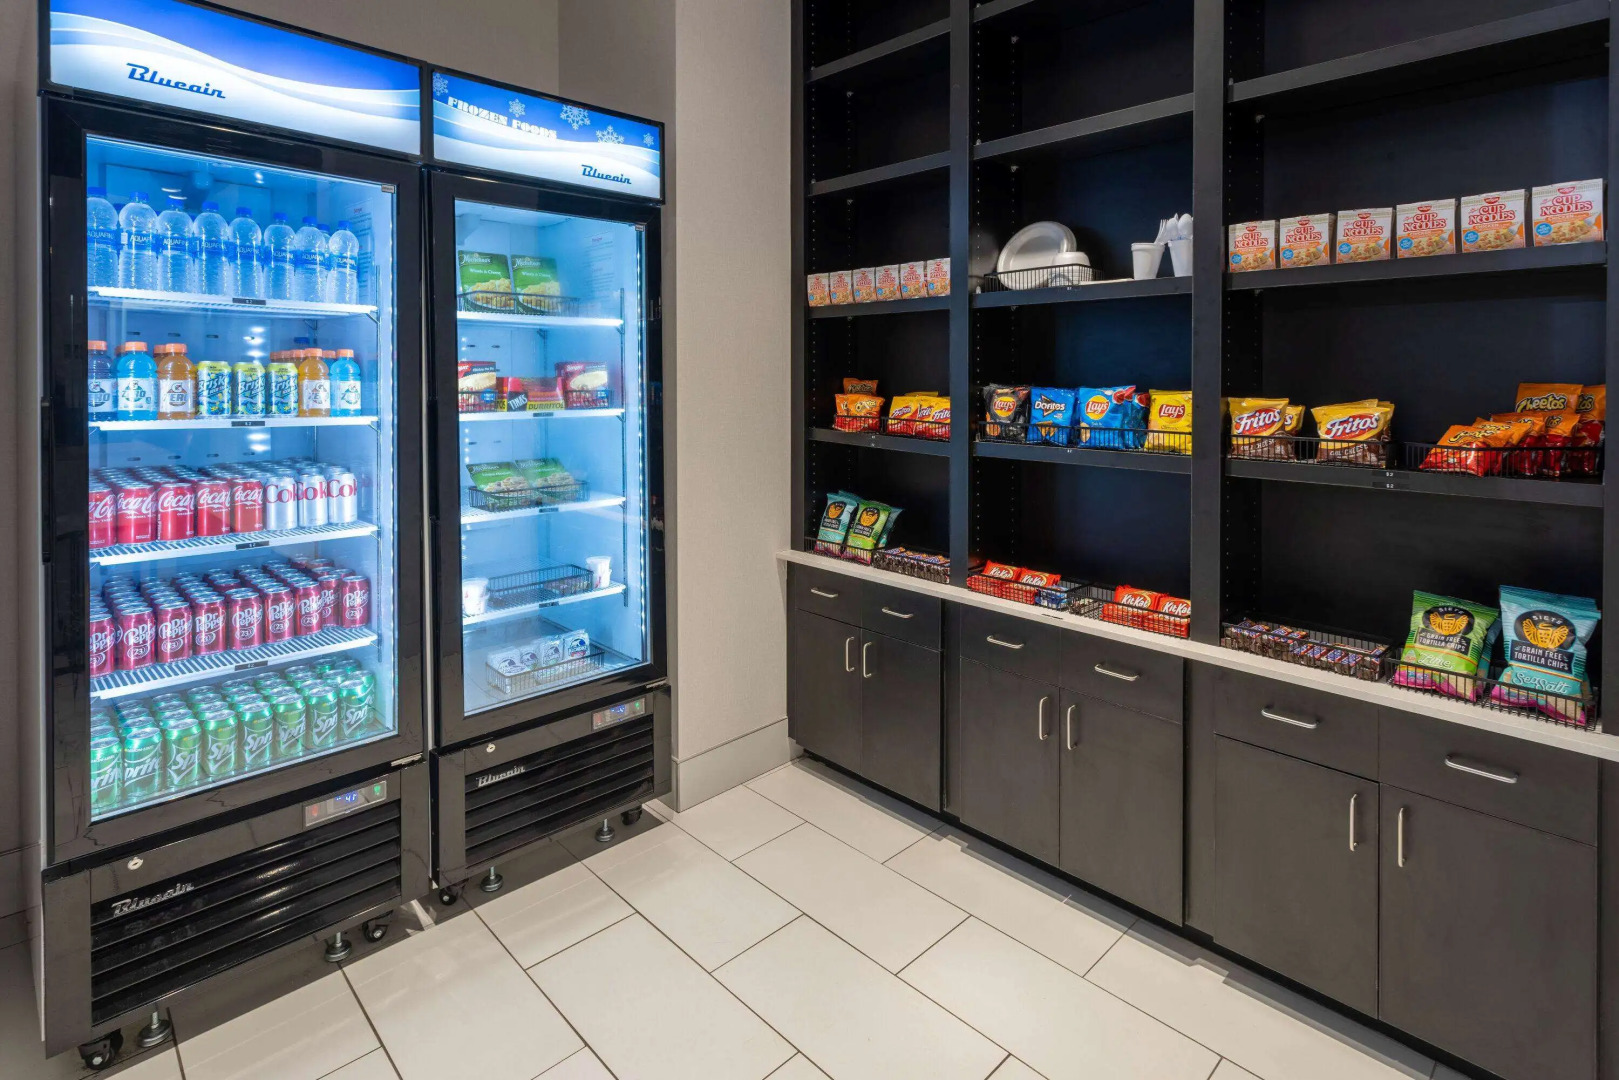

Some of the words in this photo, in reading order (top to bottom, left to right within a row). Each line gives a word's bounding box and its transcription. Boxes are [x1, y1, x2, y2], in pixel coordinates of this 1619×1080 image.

[126, 62, 227, 99] Blueair
[447, 96, 508, 128] FROZEN
[511, 118, 558, 140] FOODS
[581, 164, 632, 185] Blueair
[1552, 194, 1582, 206] CUP
[1478, 203, 1505, 215] CUP
[1540, 200, 1593, 216] NOODLES
[1353, 219, 1377, 229] CUP
[1412, 212, 1438, 223] CUP
[1468, 210, 1515, 225] NOODLES
[1293, 225, 1315, 235] CUP
[1343, 225, 1384, 237] NOODLES
[1403, 218, 1447, 232] NOODLES
[1285, 231, 1322, 243] NOODLES
[1034, 400, 1066, 411] Doritos
[1514, 393, 1568, 413] Cheetos
[1160, 404, 1185, 418] Lay's
[1234, 409, 1281, 434] Fritos
[1324, 412, 1379, 439] Fritos
[1532, 615, 1563, 625] SIETE
[1419, 636, 1446, 647] TORTILLA
[1446, 641, 1466, 652] CHIPS
[1426, 632, 1445, 640] GRAIN
[1445, 635, 1461, 643] FREE
[1521, 645, 1543, 656] GRAIN
[1544, 650, 1562, 660] FREE
[1514, 651, 1545, 665] TORTILLA
[1547, 658, 1569, 671] CHIPS
[1513, 671, 1540, 686] Sea
[1536, 679, 1572, 694] Salt
